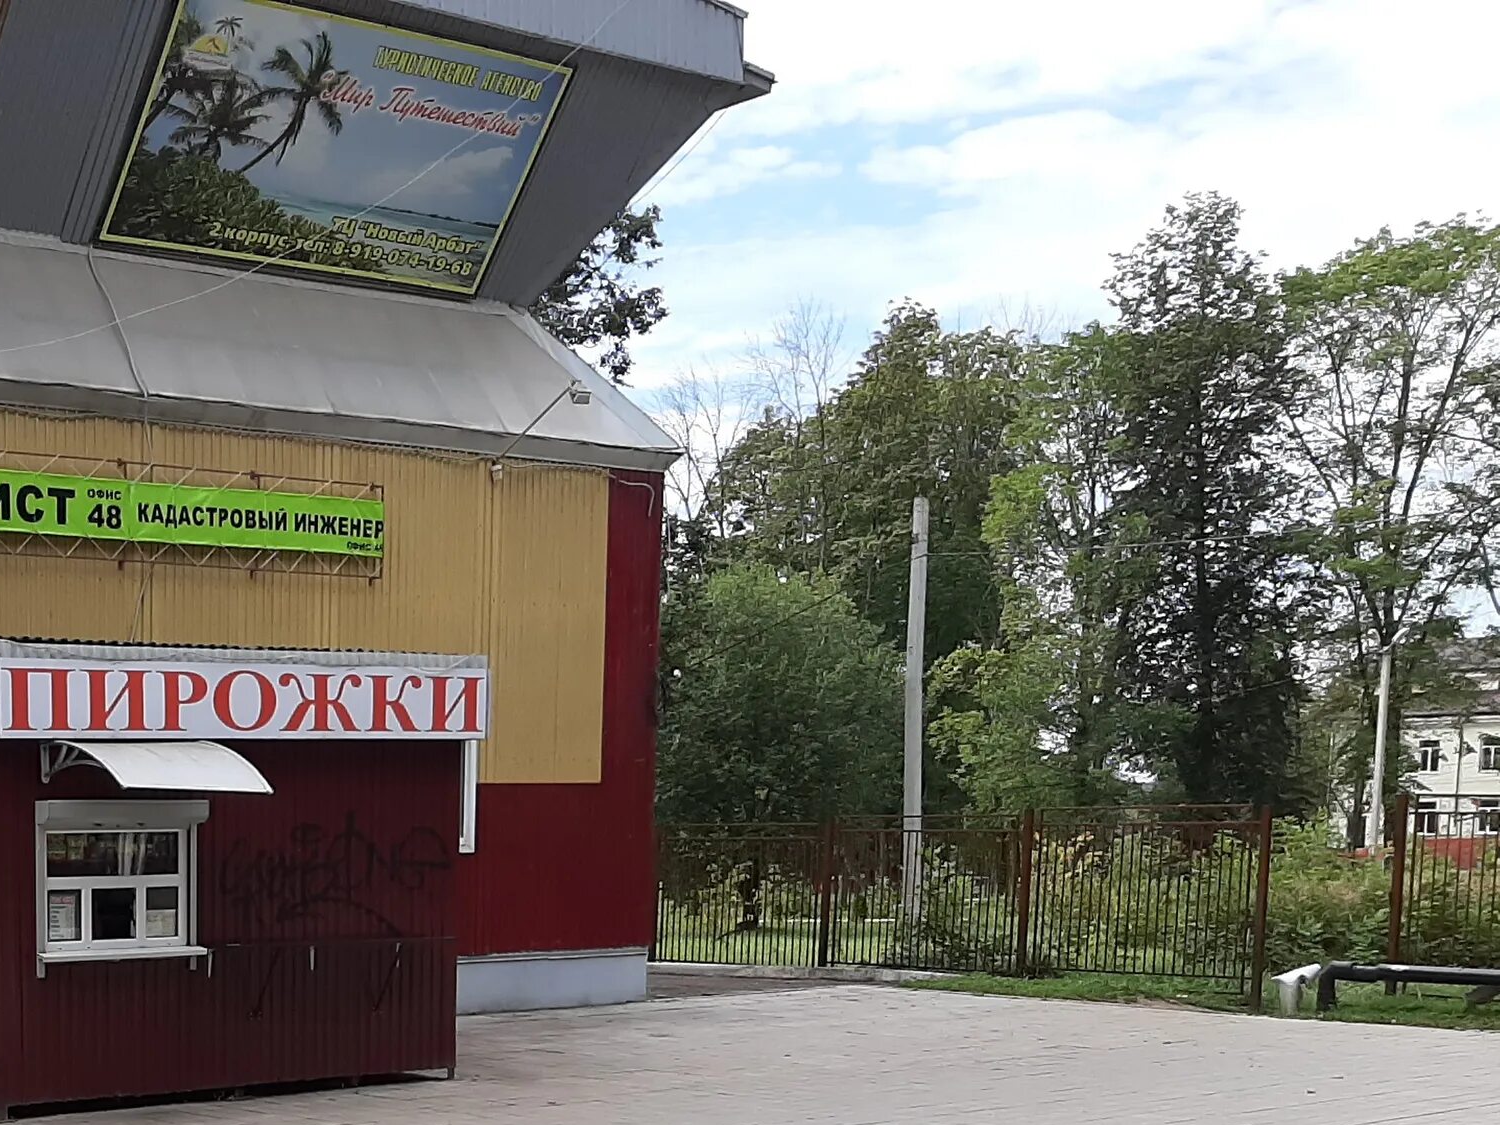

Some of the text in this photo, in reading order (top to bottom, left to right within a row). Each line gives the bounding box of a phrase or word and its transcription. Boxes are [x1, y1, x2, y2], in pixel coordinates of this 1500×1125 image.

[333, 216, 485, 256] ТЦ "Новый Арбат"
[332, 239, 474, 277] 8-919-074-19-68
[87, 488, 122, 501] ОФИС
[87, 504, 122, 529] 48
[137, 502, 384, 539] КАДАСТРОВЫЙ ИНЖЕНЕР
[3, 668, 486, 733] ПИРОЖКИ
